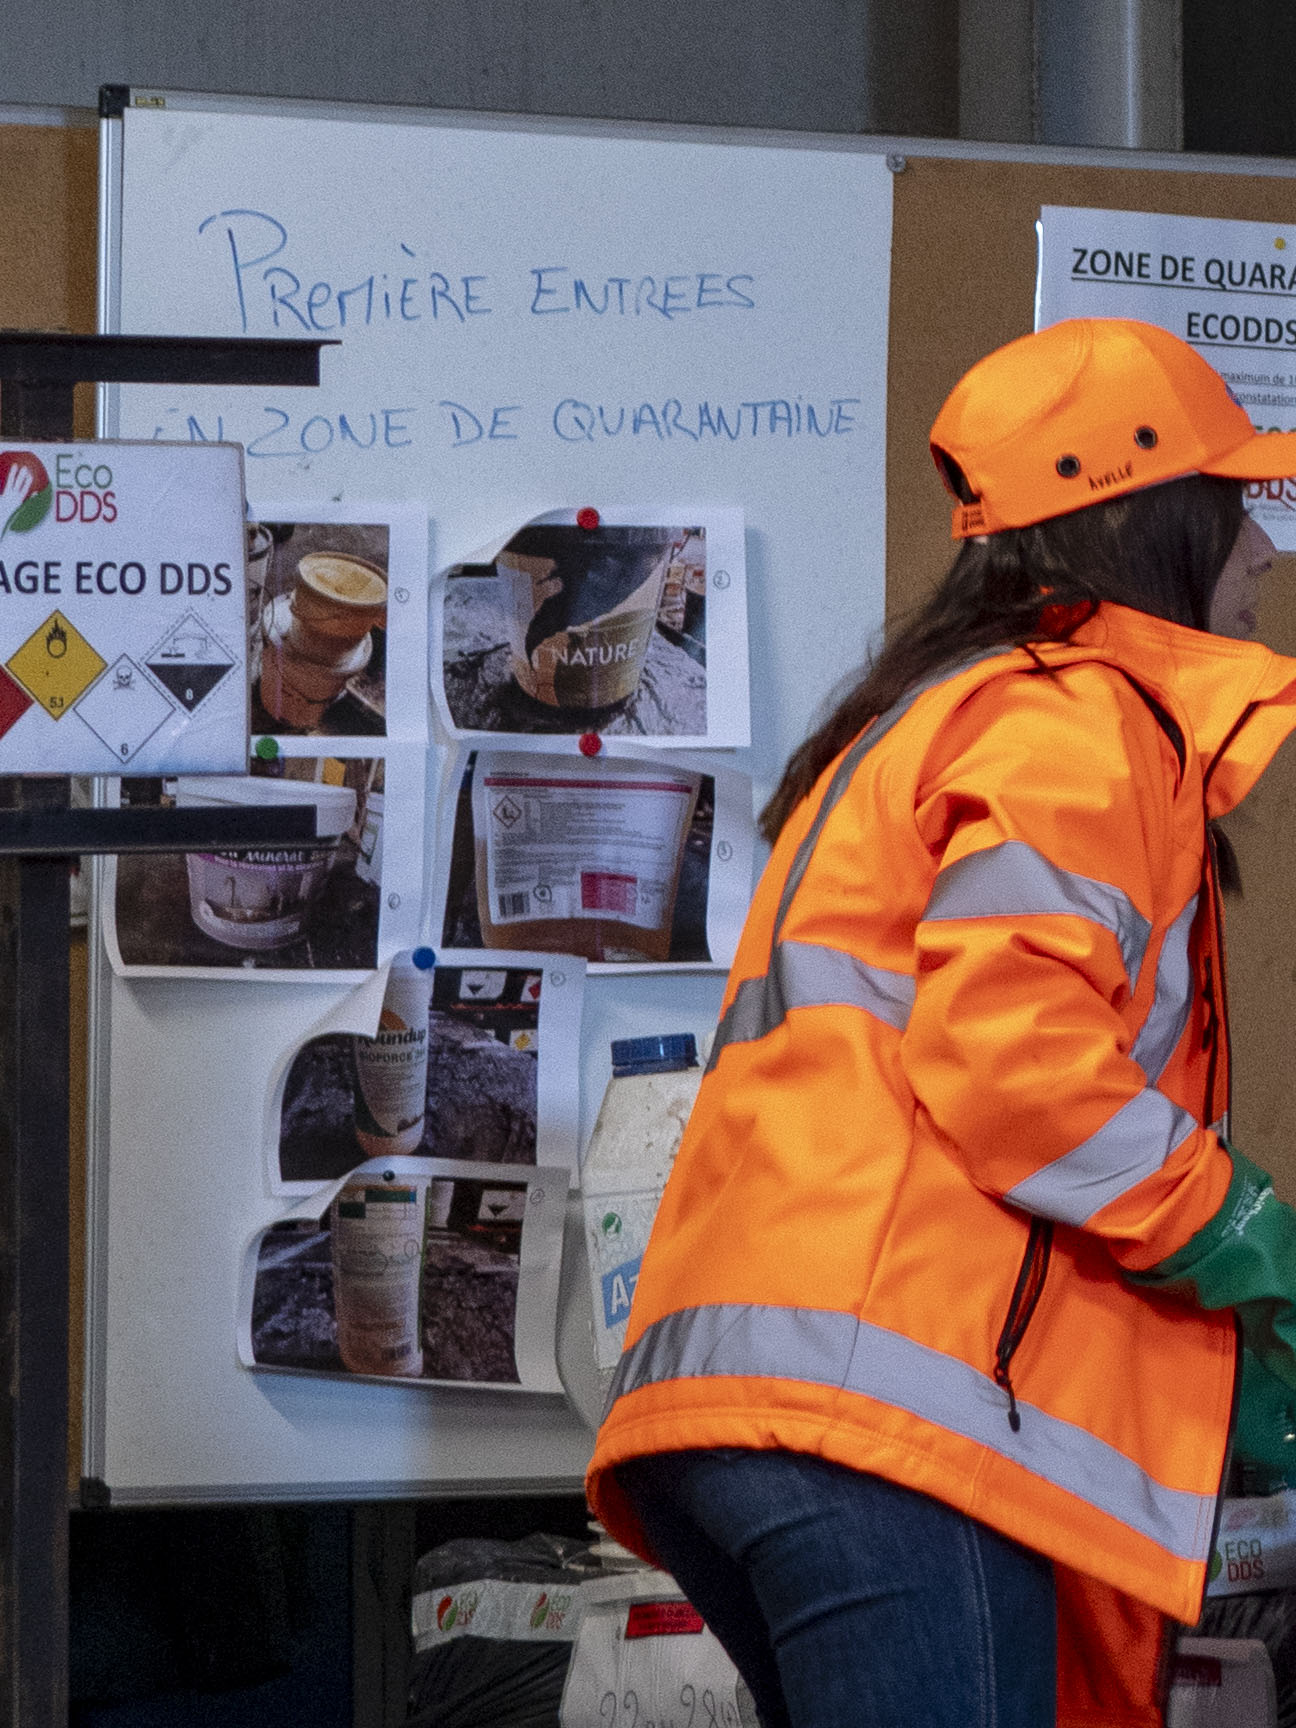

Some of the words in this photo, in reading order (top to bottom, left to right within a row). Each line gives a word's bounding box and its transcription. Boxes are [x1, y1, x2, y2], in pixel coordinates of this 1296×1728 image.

[1071, 247, 1151, 279] ZONE
[1161, 254, 1195, 283] DE
[531, 266, 757, 319] ENTREES
[1272, 373, 1286, 386] de
[248, 406, 414, 458] ZONE
[450, 401, 520, 447] DE
[552, 394, 862, 443] QUARANTAINE
[56, 454, 113, 489] Eco
[55, 491, 118, 524] DDS
[76, 561, 147, 596] ECO
[160, 562, 232, 597] DDS
[552, 638, 637, 669] NATURE
[120, 741, 129, 757] 6
